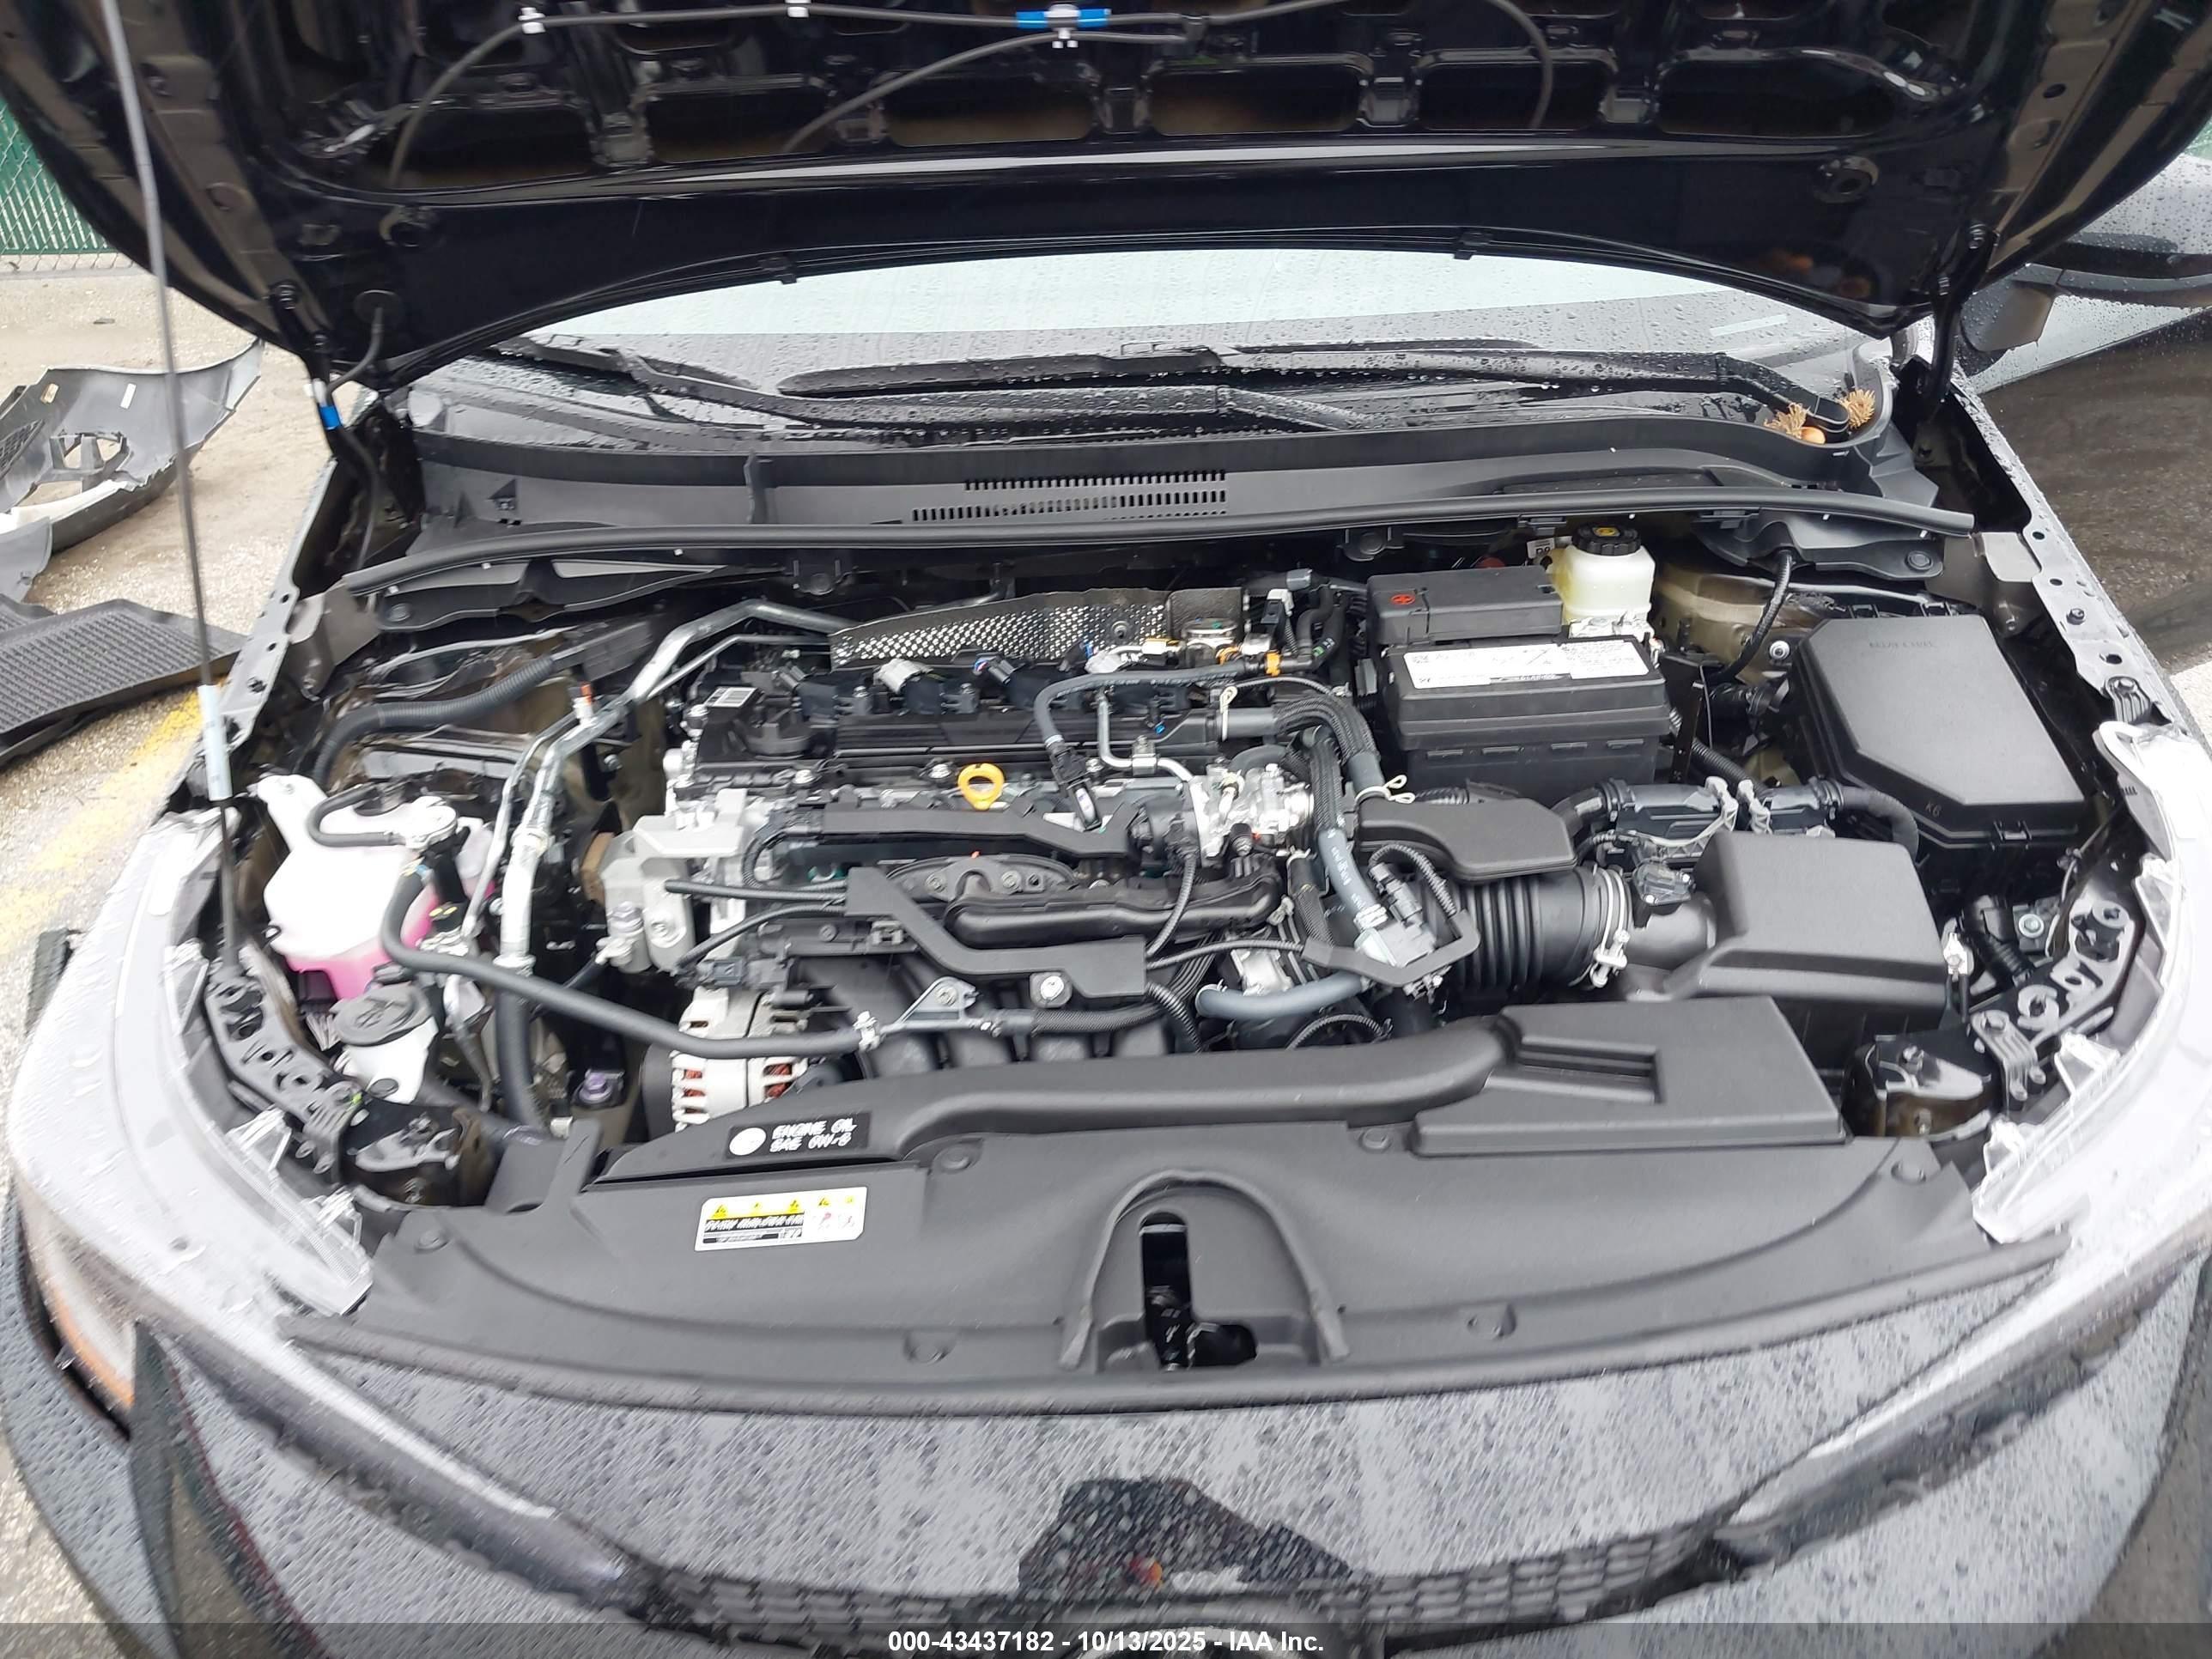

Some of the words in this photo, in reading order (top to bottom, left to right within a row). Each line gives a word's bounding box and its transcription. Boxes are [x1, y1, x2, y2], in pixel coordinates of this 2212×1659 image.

[771, 1121, 827, 1139] ENGINE
[830, 1118, 858, 1133] OIL
[769, 1137, 803, 1152] SAE
